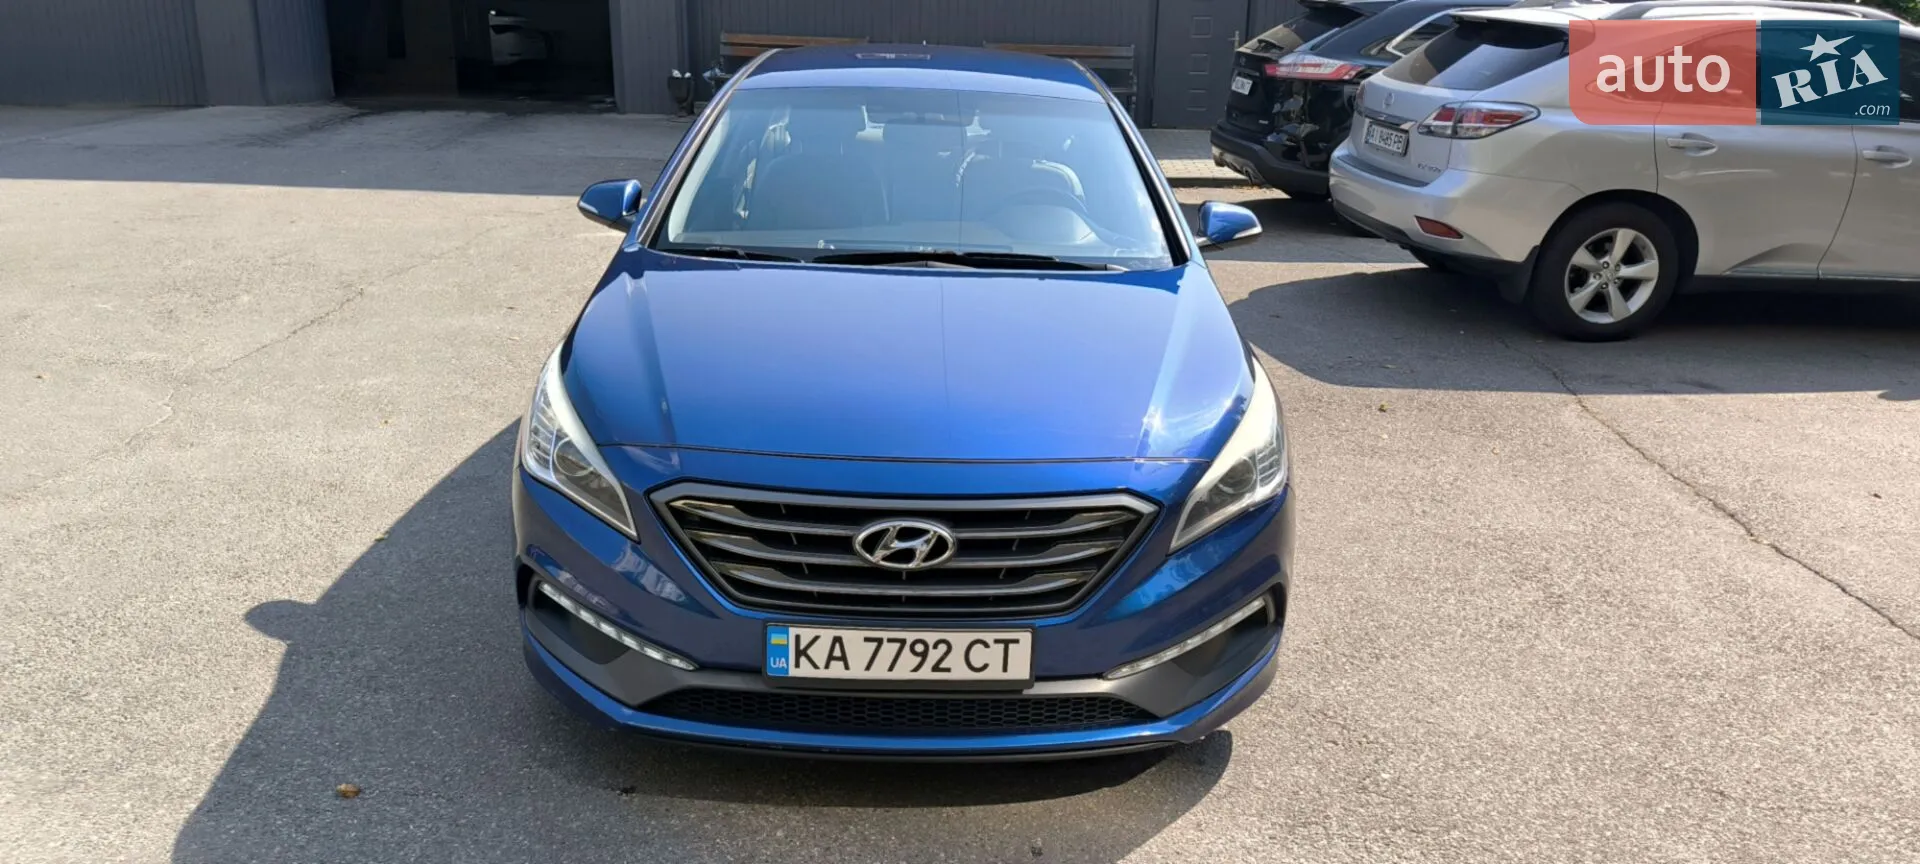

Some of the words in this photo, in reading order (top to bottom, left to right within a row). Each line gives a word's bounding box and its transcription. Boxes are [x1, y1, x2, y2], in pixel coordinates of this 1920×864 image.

[771, 657, 787, 669] UA
[795, 634, 850, 670] KA
[863, 637, 953, 672] 7792
[964, 639, 1020, 673] CT
